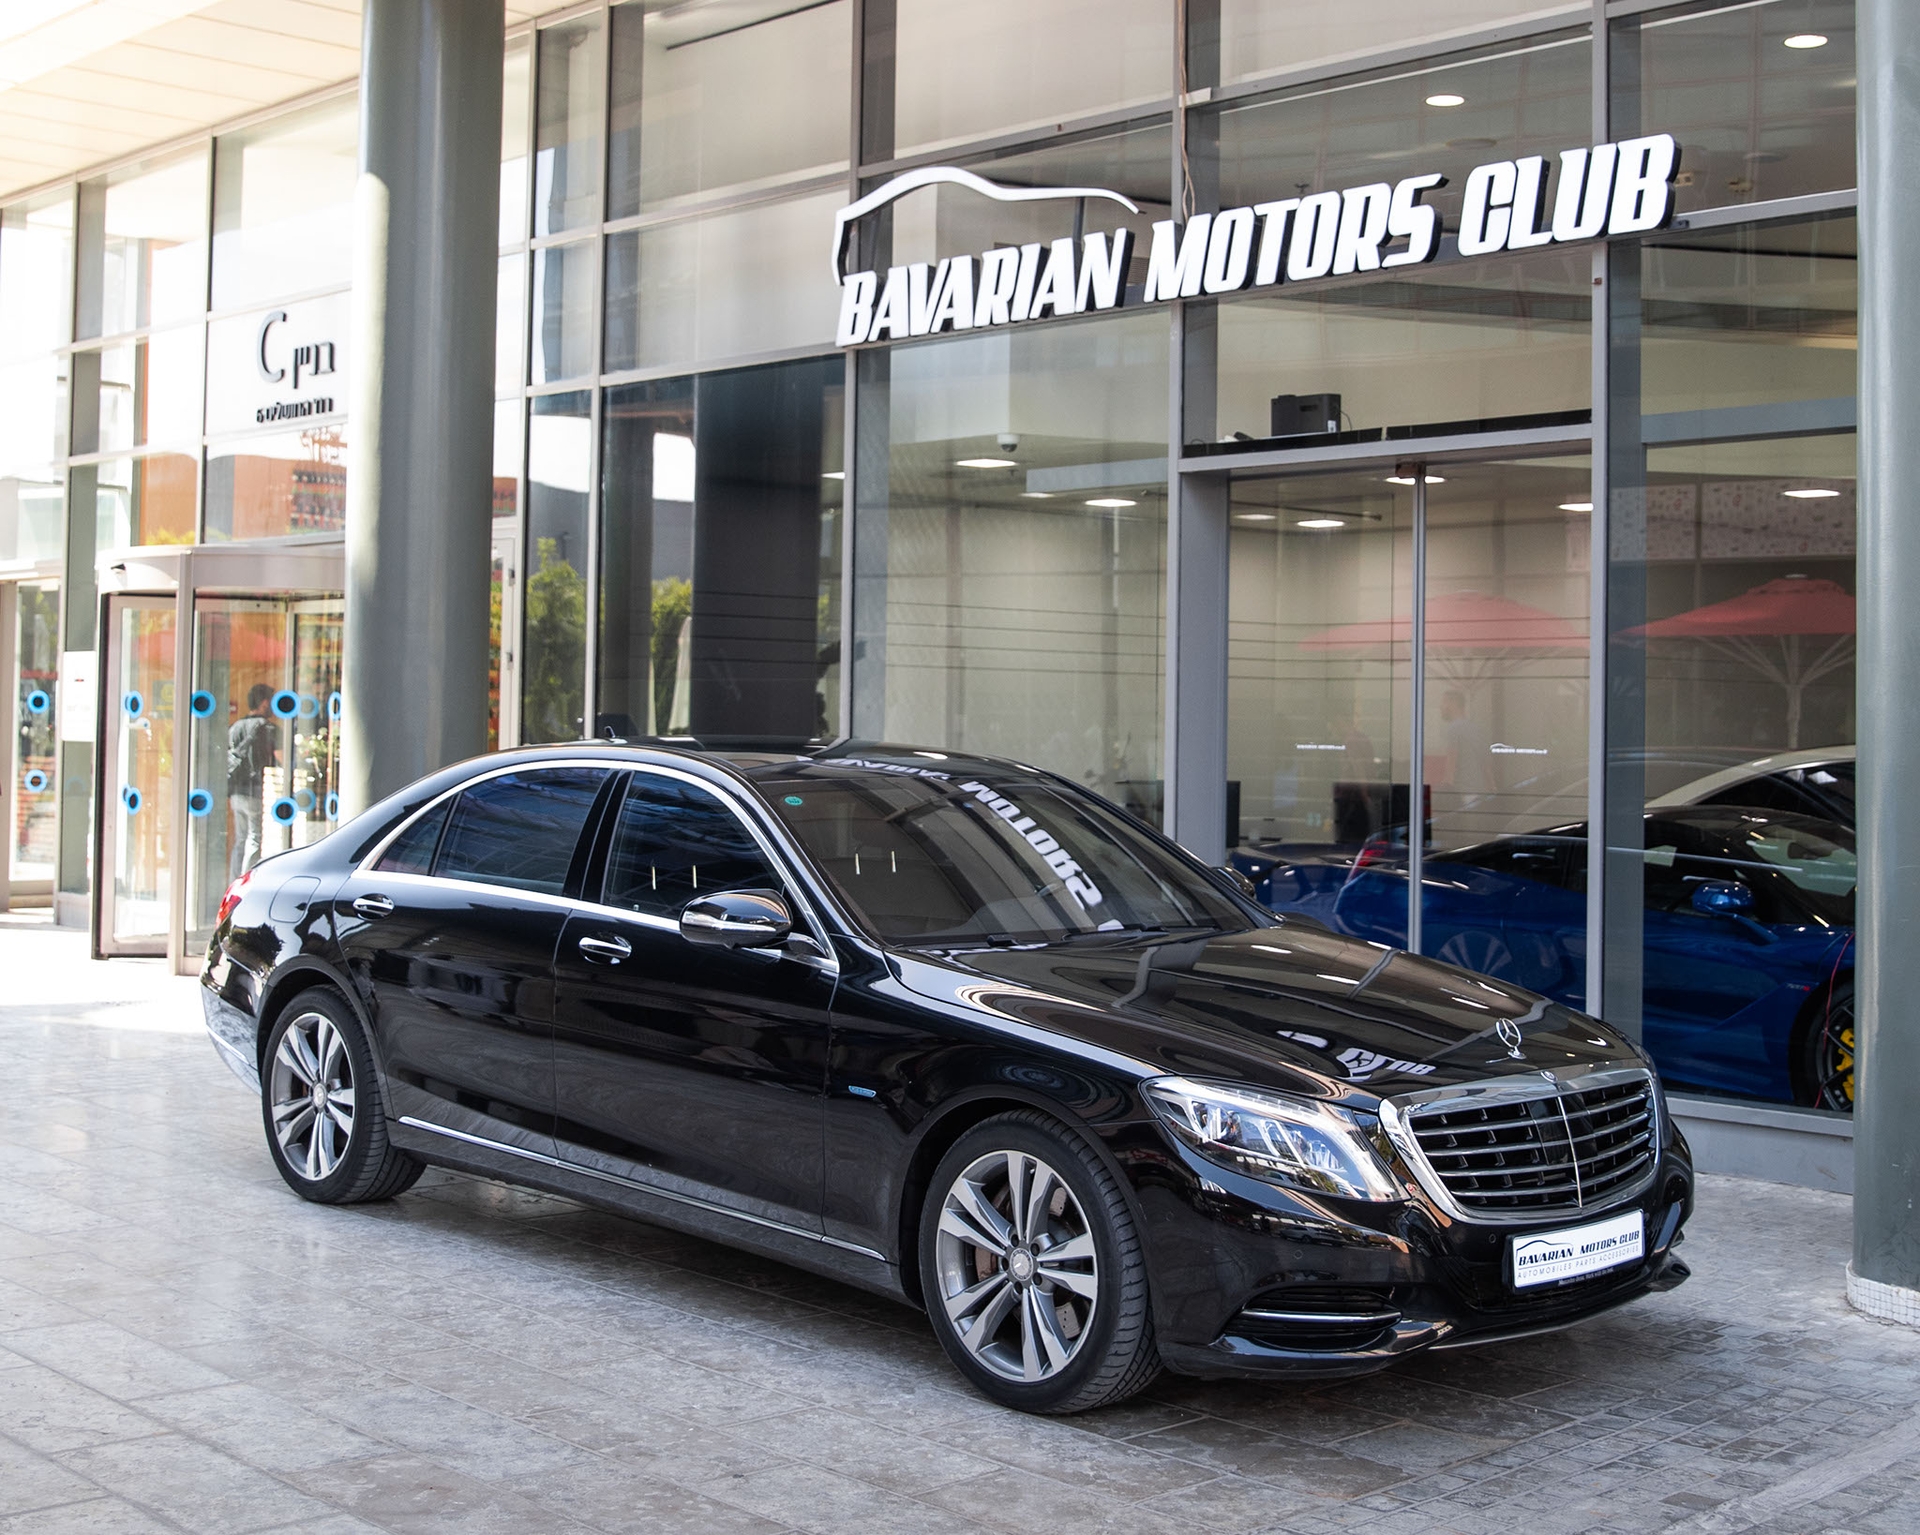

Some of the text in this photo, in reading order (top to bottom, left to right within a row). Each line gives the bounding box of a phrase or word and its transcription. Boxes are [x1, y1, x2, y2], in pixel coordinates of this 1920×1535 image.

[836, 133, 1680, 347] BAVARIAN MOTORS CLUB
[257, 310, 335, 390] בניין C
[1517, 1262, 1572, 1279] AUTOMOBILES
[1575, 1256, 1597, 1268] PARTS
[1598, 1244, 1639, 1262] ACCESSORIES
[1518, 1230, 1640, 1266] BAVARIAN MOTORS CLUB
